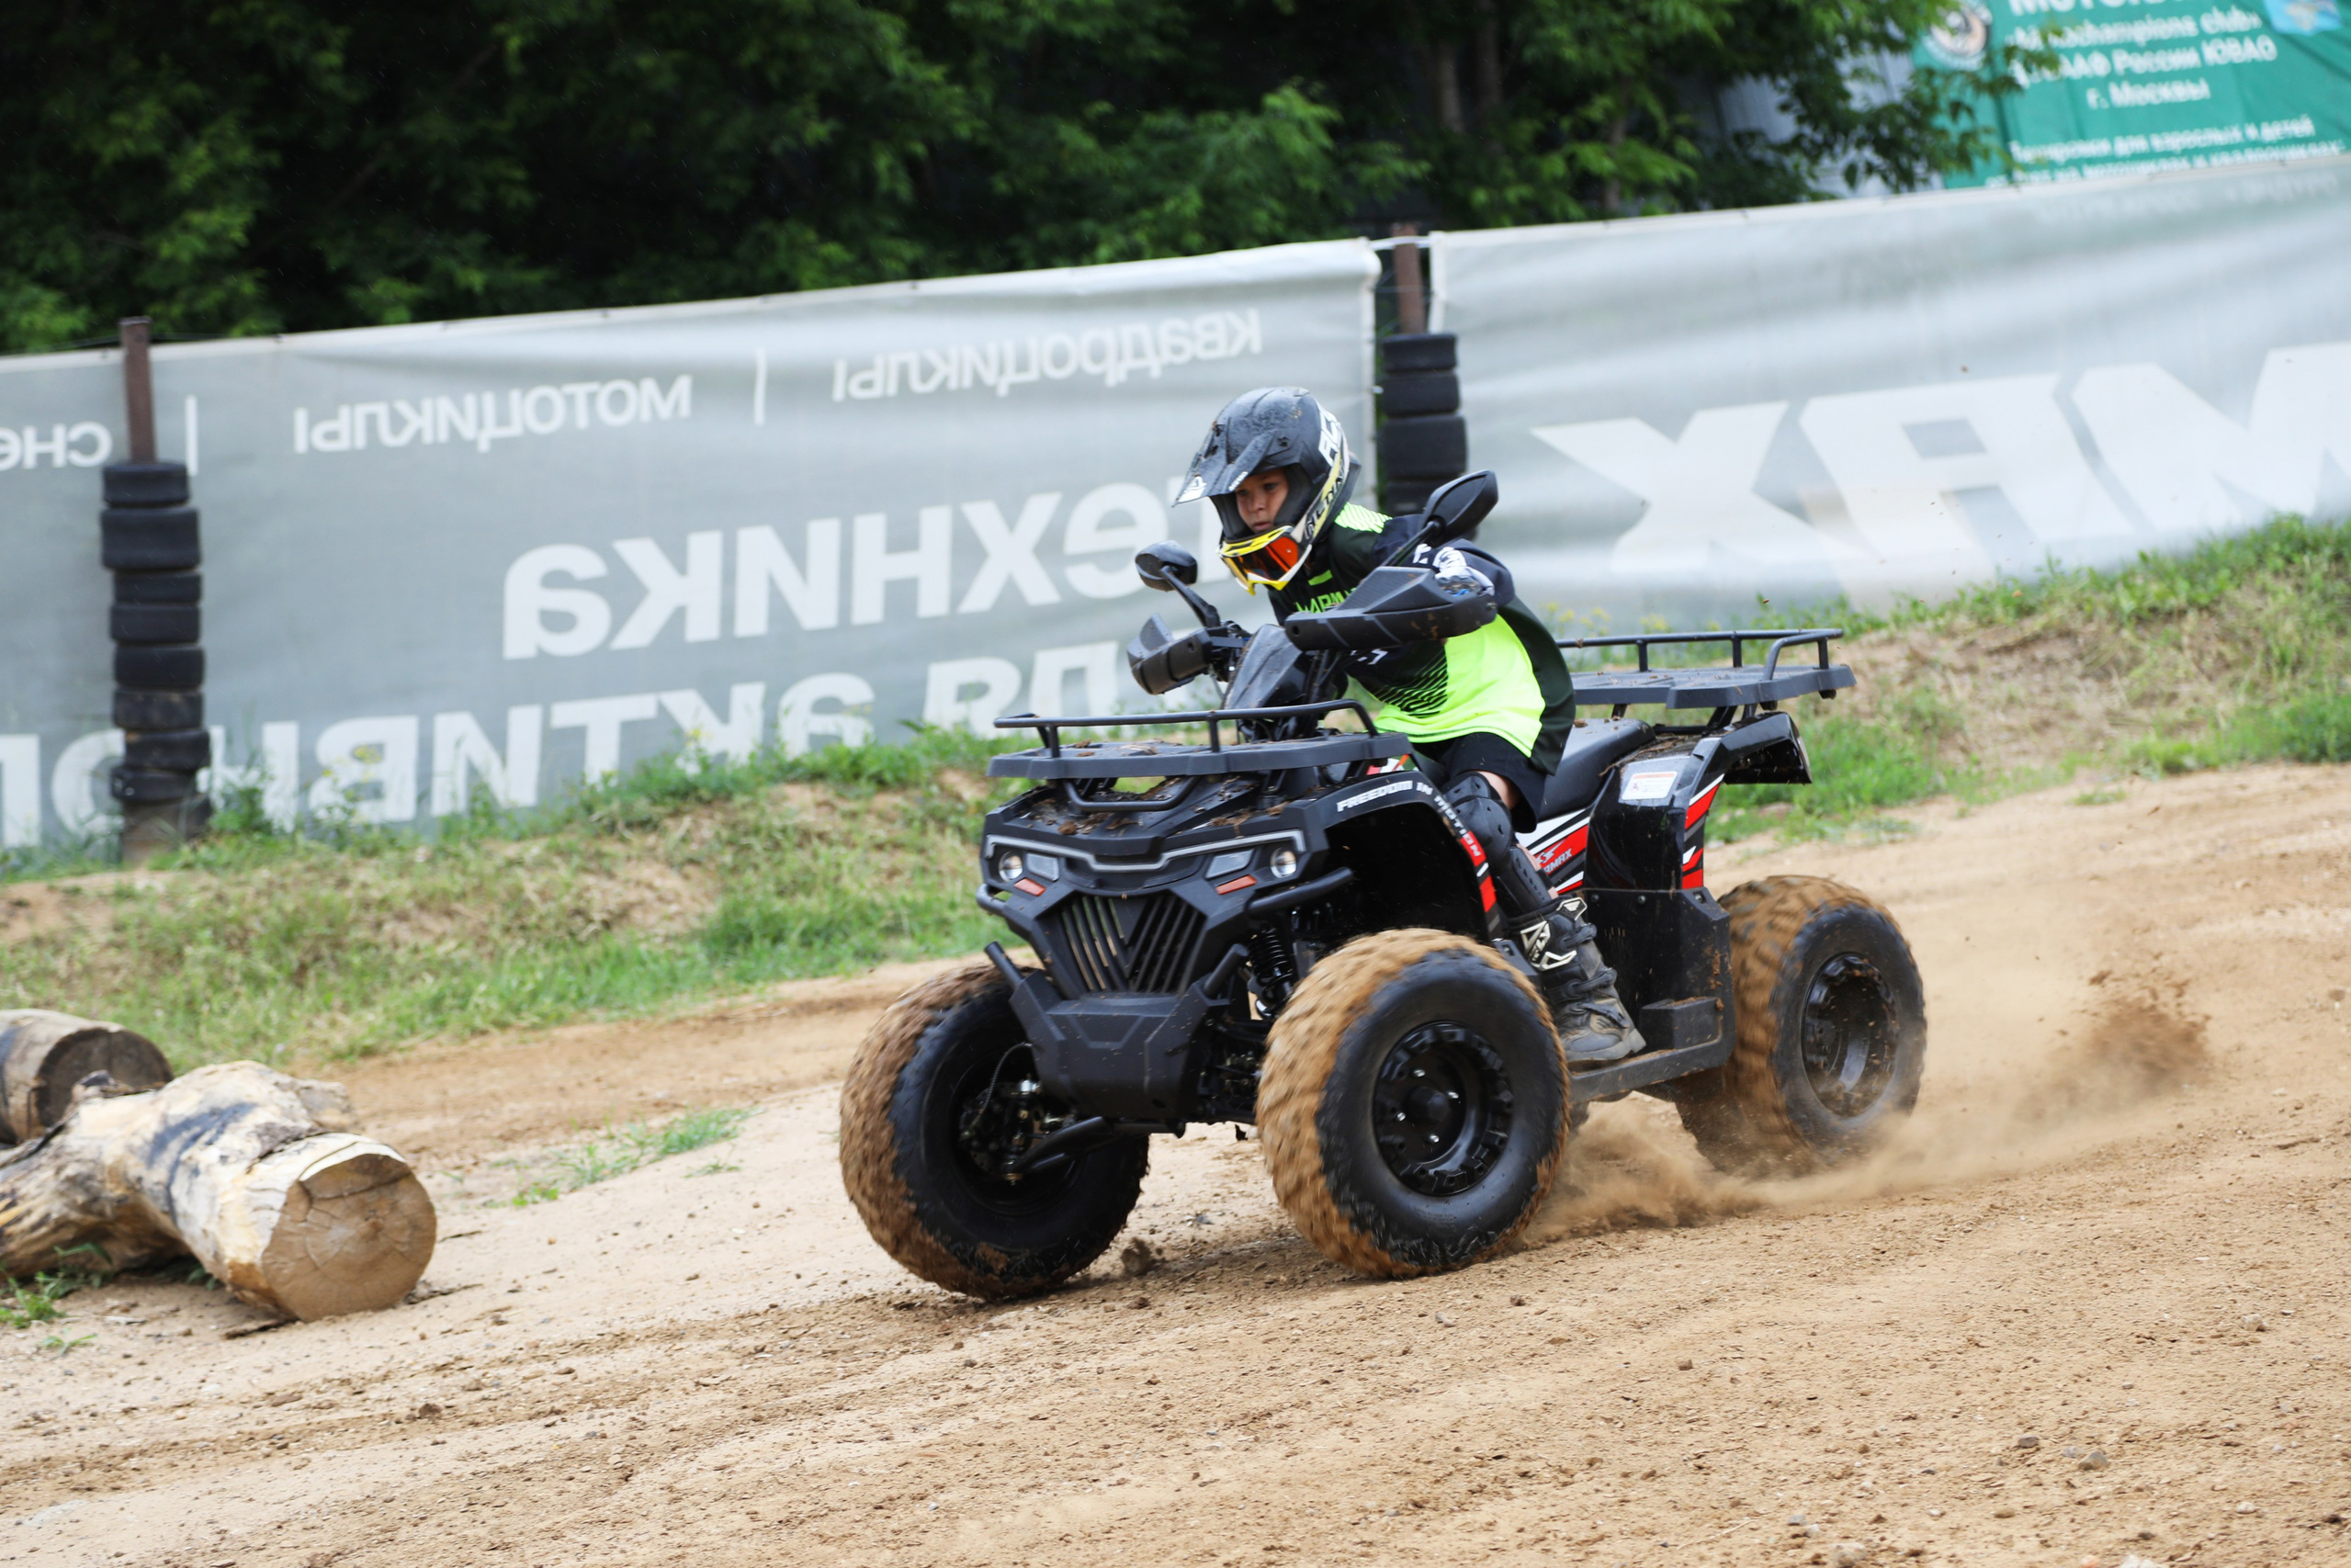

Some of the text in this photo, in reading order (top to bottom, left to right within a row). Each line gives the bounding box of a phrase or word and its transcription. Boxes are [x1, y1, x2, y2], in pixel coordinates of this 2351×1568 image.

[2111, 46, 2201, 75] России
[2201, 34, 2278, 66] ЮВАО
[2109, 78, 2210, 107] Москвы
[2260, 112, 2316, 142] детей
[1336, 780, 1481, 857] FREEDOM IN MOTION
